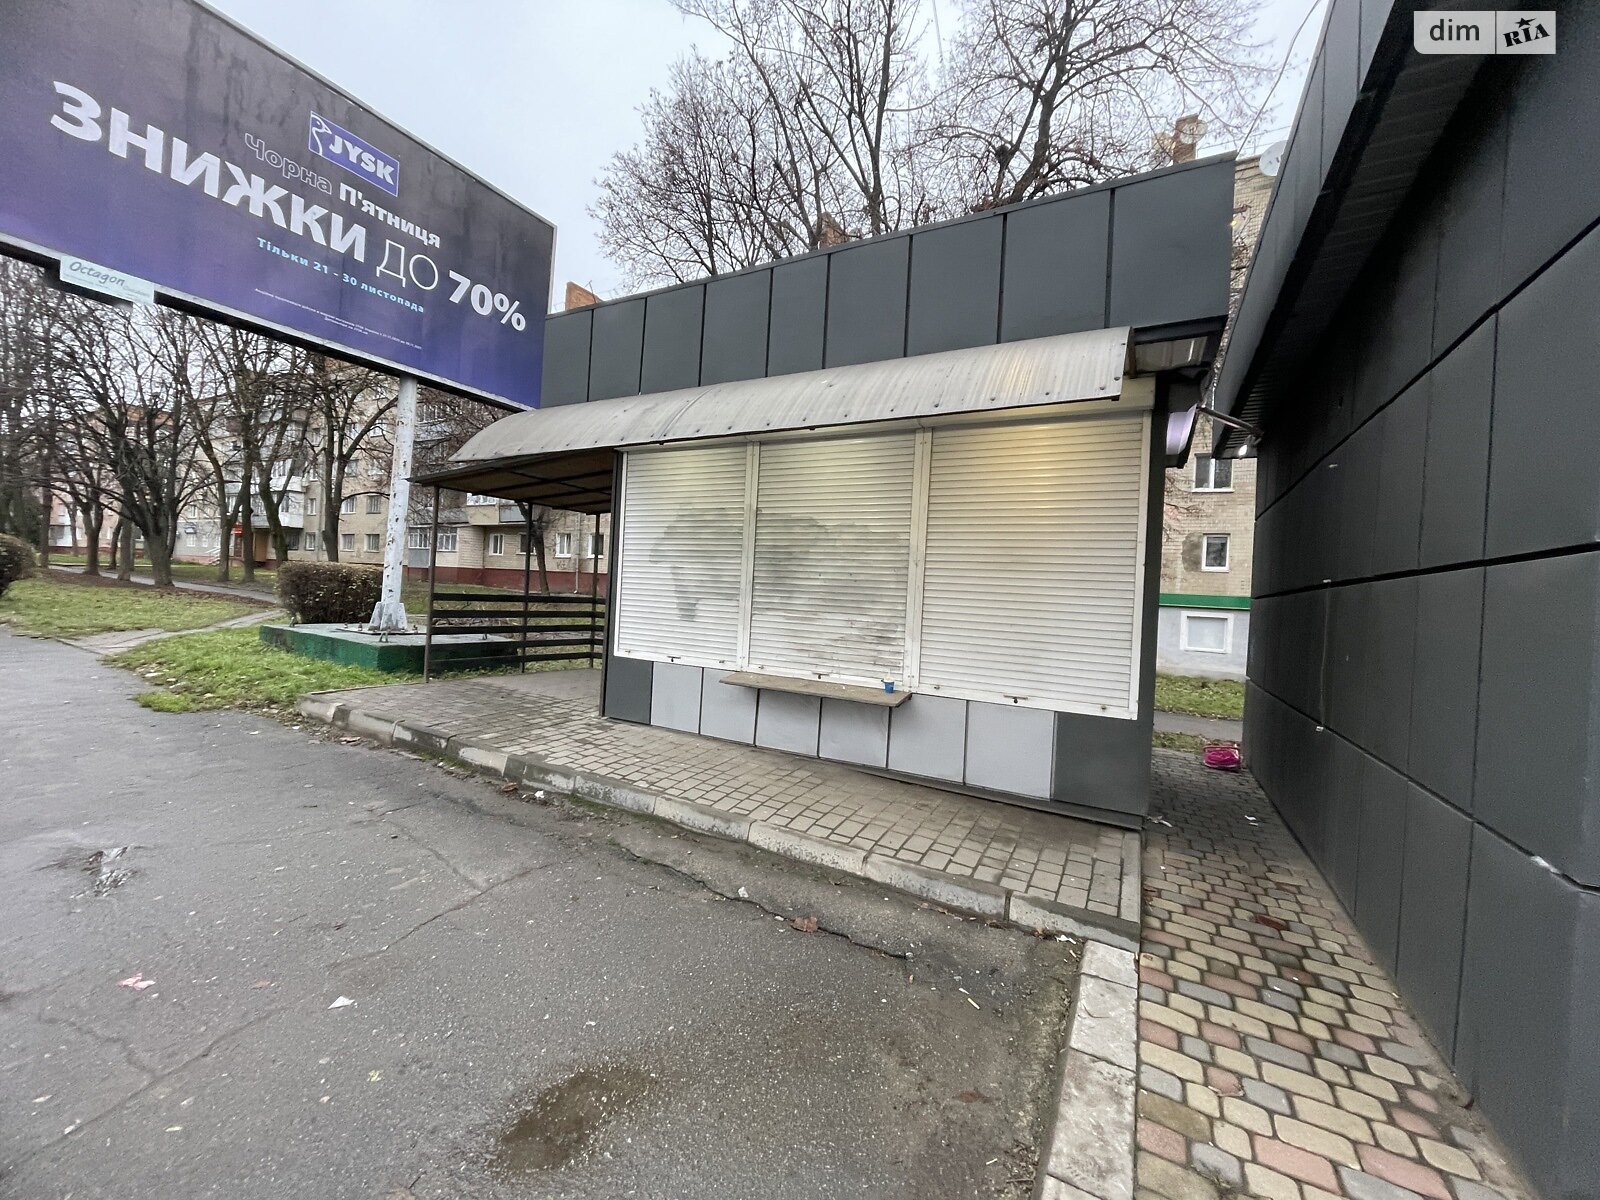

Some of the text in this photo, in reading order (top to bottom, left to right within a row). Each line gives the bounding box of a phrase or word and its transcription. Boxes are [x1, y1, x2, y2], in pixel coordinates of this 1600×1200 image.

[244, 132, 441, 249] Чорна П'ятниця
[329, 135, 395, 186] JYSK
[50, 80, 367, 263] ЗНИЖКИ
[376, 239, 439, 290] ДО
[449, 270, 526, 331] 70%
[69, 261, 126, 287] Octagon
[257, 237, 309, 267] Тільки
[313, 261, 328, 275] 21
[342, 273, 358, 287] 30
[360, 283, 425, 313] листопада
